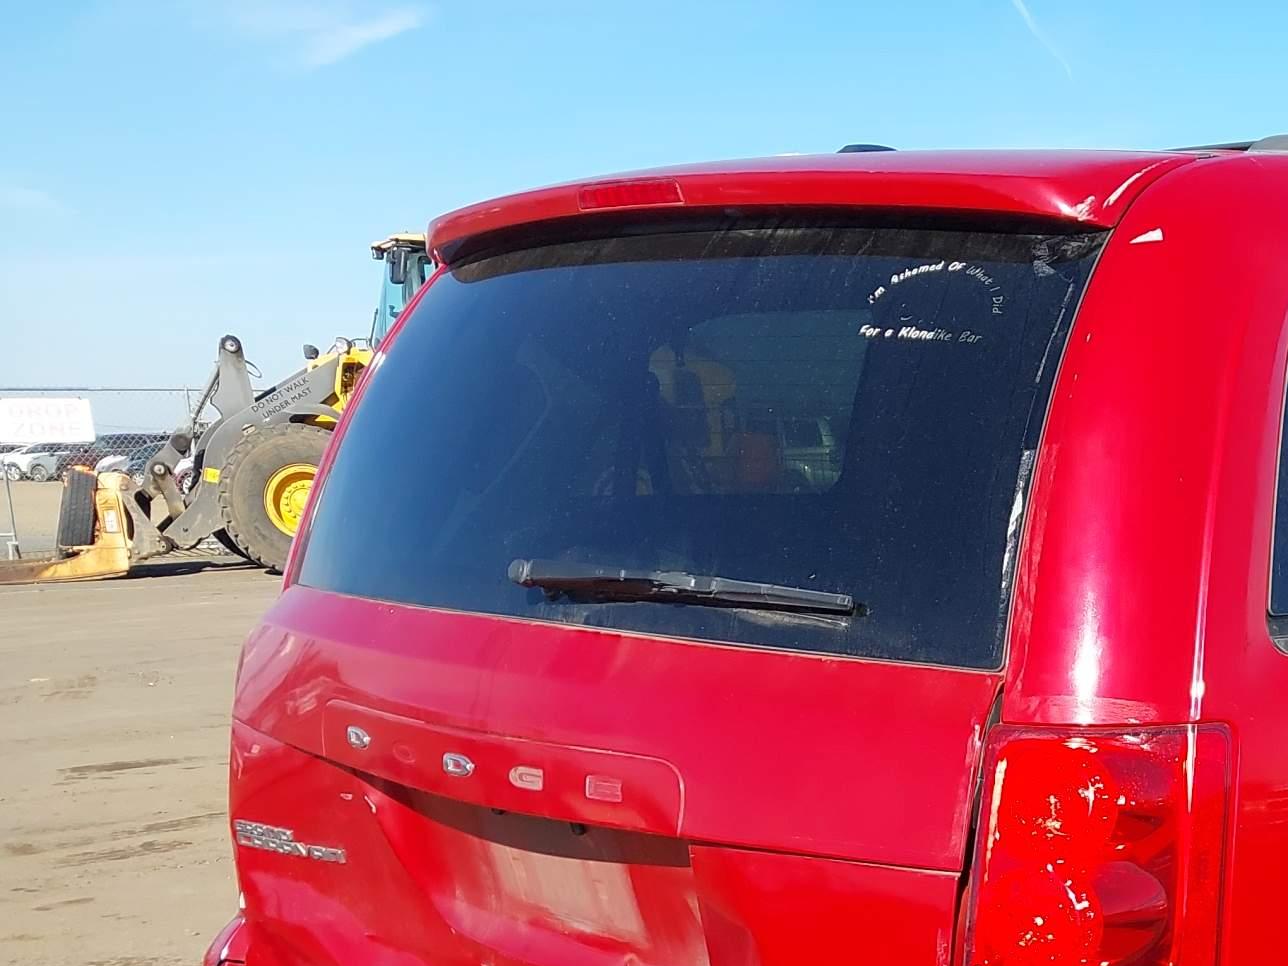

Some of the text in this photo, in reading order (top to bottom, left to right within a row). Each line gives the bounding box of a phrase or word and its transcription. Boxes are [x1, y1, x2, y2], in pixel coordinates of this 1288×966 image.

[890, 260, 945, 285] Ashamed
[966, 265, 993, 286] What
[991, 295, 1004, 315] Did
[859, 324, 984, 344] For a Klondike Bar
[251, 377, 310, 413] DO NOT WALK
[262, 386, 312, 419] UNDER MAST
[13, 422, 81, 437] ZONE
